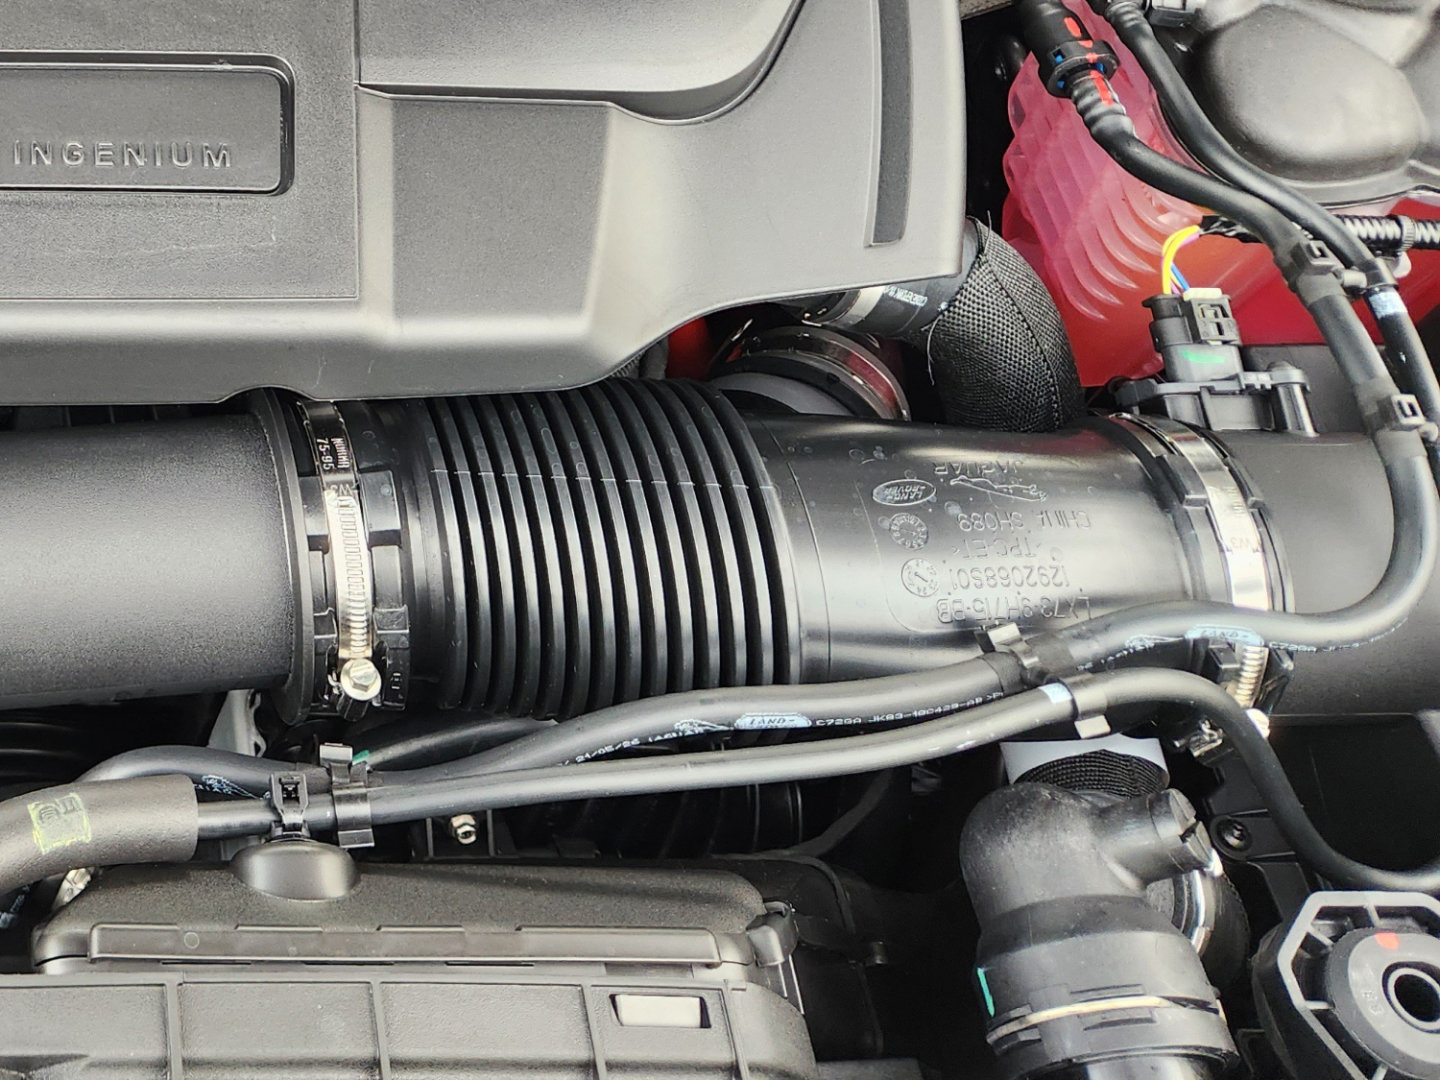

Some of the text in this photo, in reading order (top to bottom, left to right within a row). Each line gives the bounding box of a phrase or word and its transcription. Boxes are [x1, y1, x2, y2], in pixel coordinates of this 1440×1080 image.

[13, 139, 233, 169] INGENIUM
[316, 437, 336, 471] 75-95
[330, 437, 352, 470] NORMA
[932, 459, 1024, 476] JAGUAR
